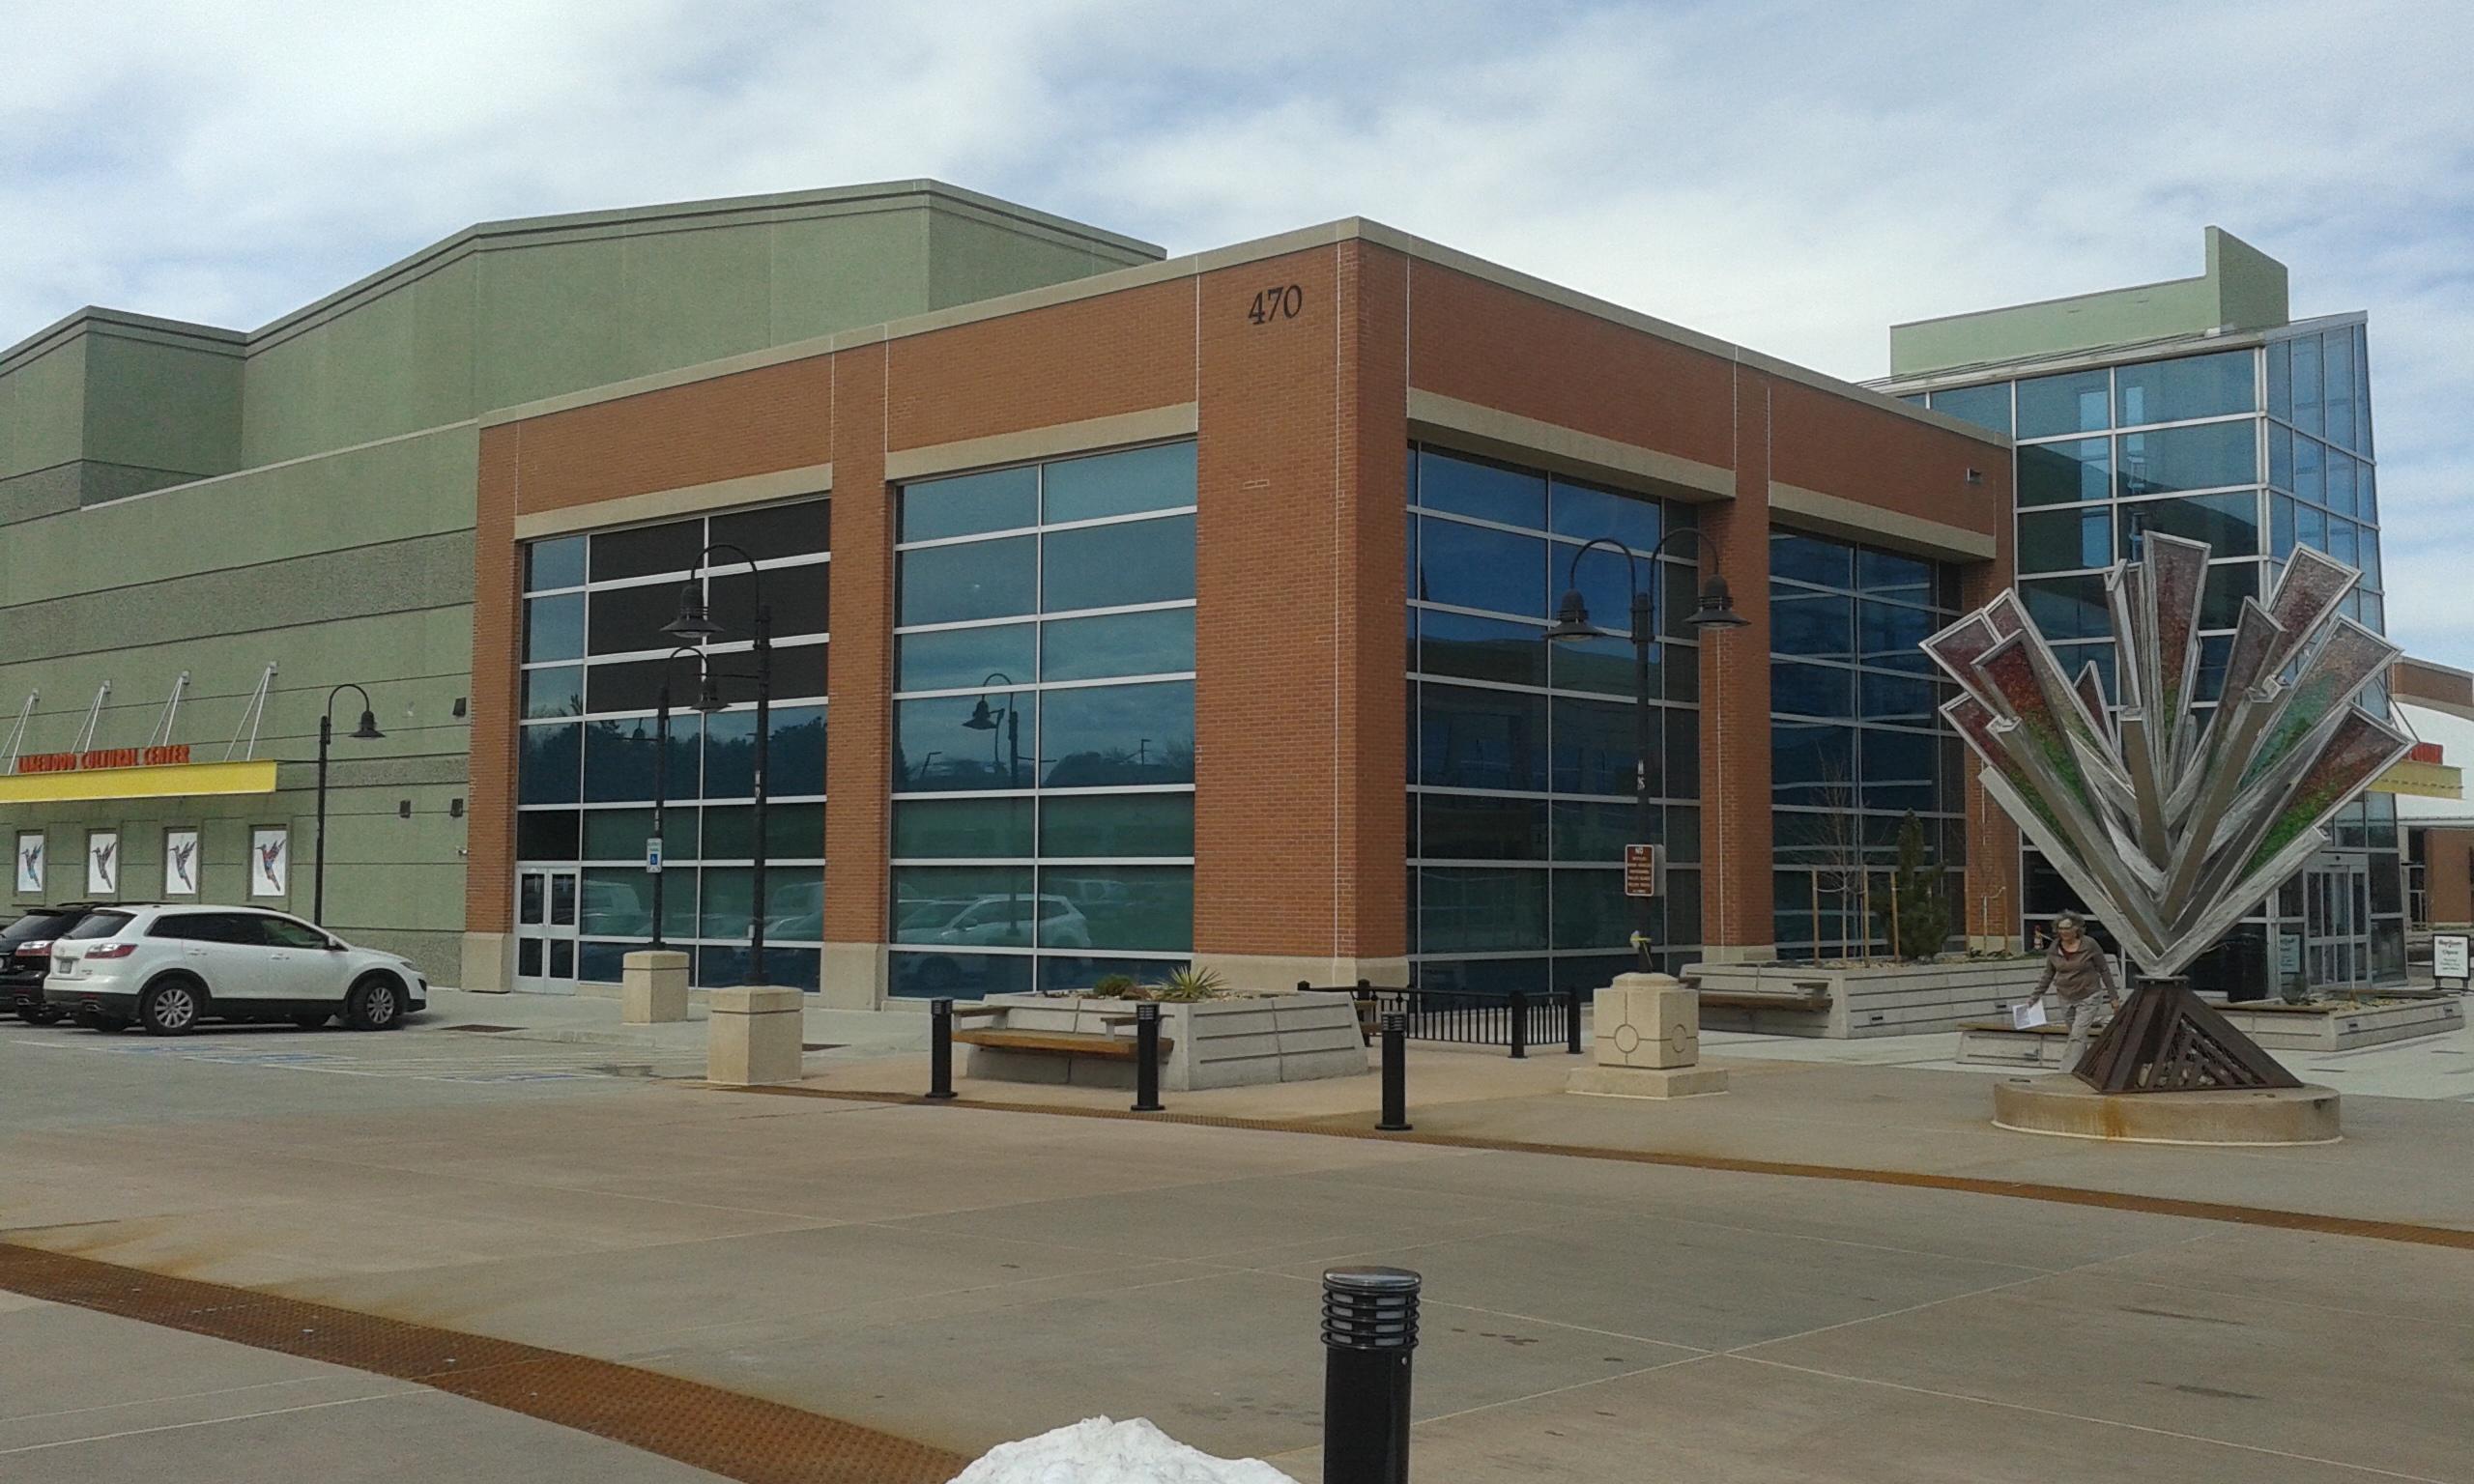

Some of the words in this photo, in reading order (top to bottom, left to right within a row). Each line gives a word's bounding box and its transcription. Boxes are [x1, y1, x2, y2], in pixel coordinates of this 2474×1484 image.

[1248, 284, 1303, 325] 470
[81, 748, 139, 770] CULTURAL
[144, 744, 189, 766] CENTER
